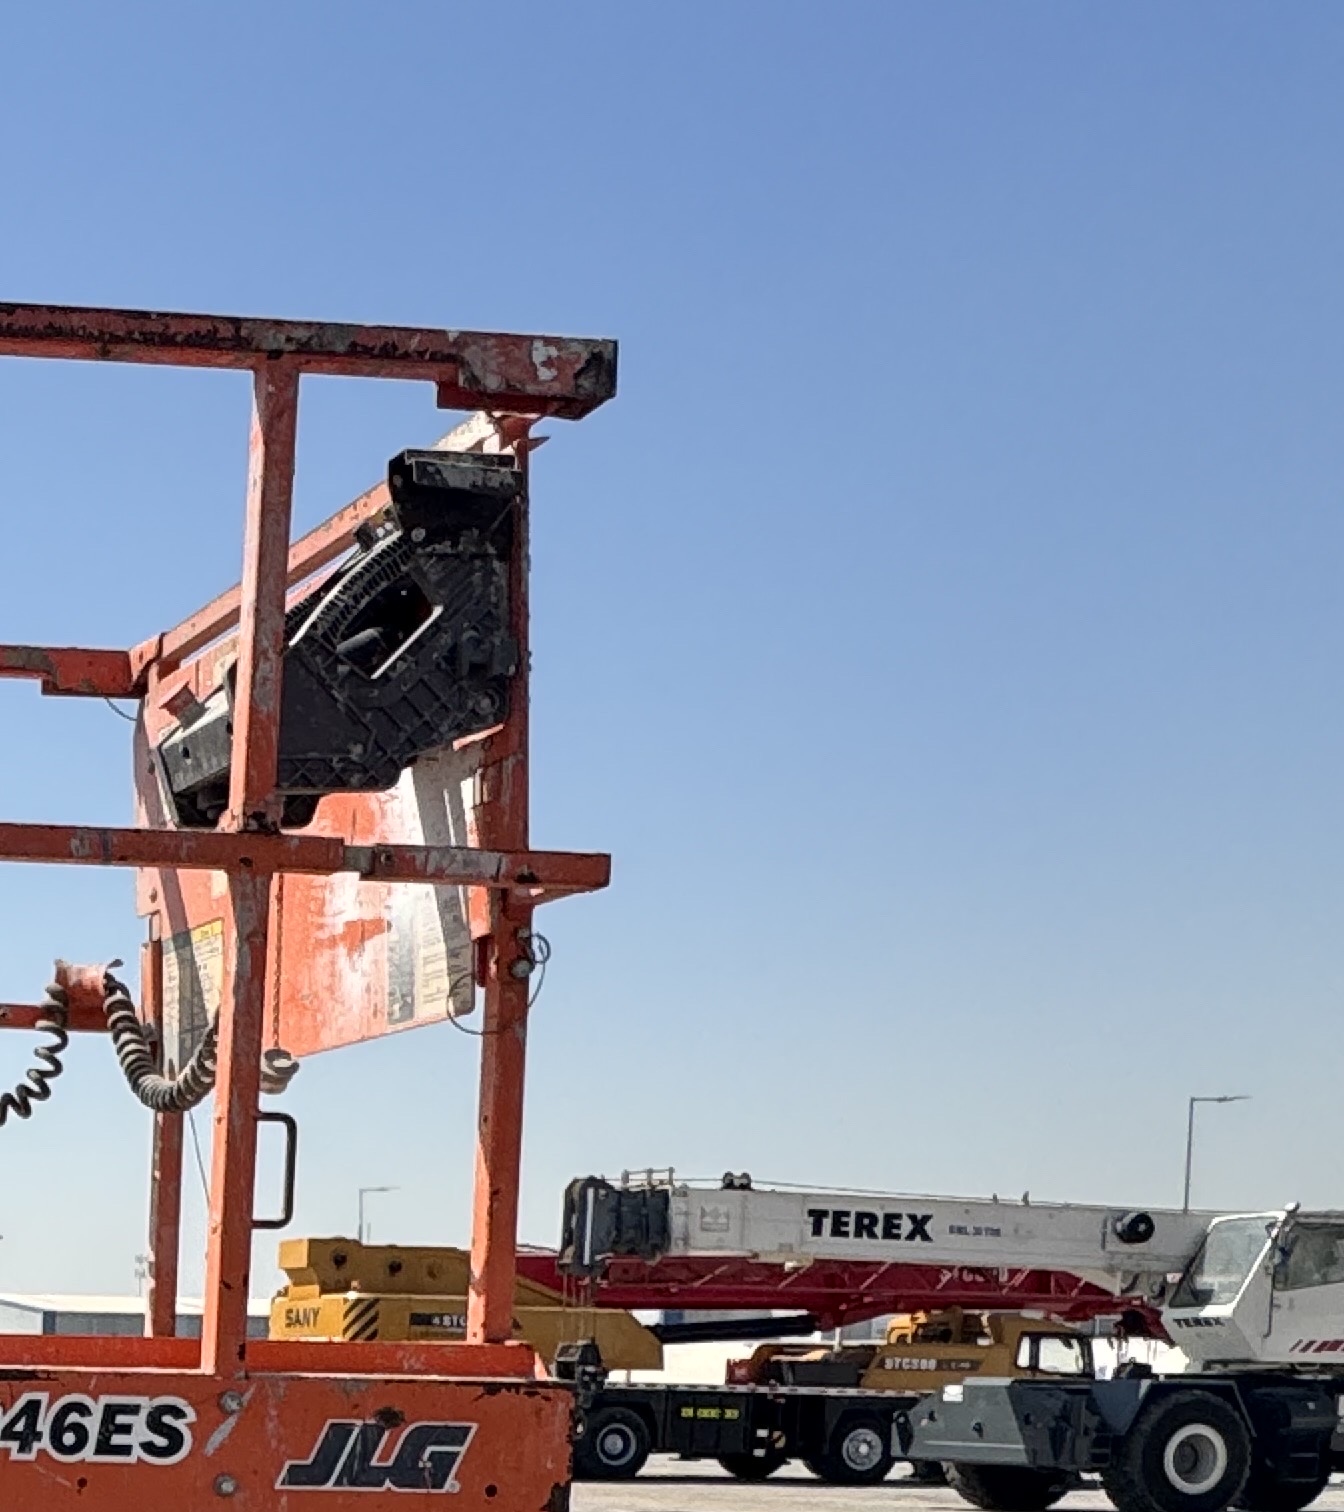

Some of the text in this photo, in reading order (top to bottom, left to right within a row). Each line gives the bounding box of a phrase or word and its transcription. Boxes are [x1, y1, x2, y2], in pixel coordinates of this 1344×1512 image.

[807, 1208, 934, 1242] TEREX
[285, 1306, 322, 1329] SANY
[275, 1419, 478, 1492] JLG
